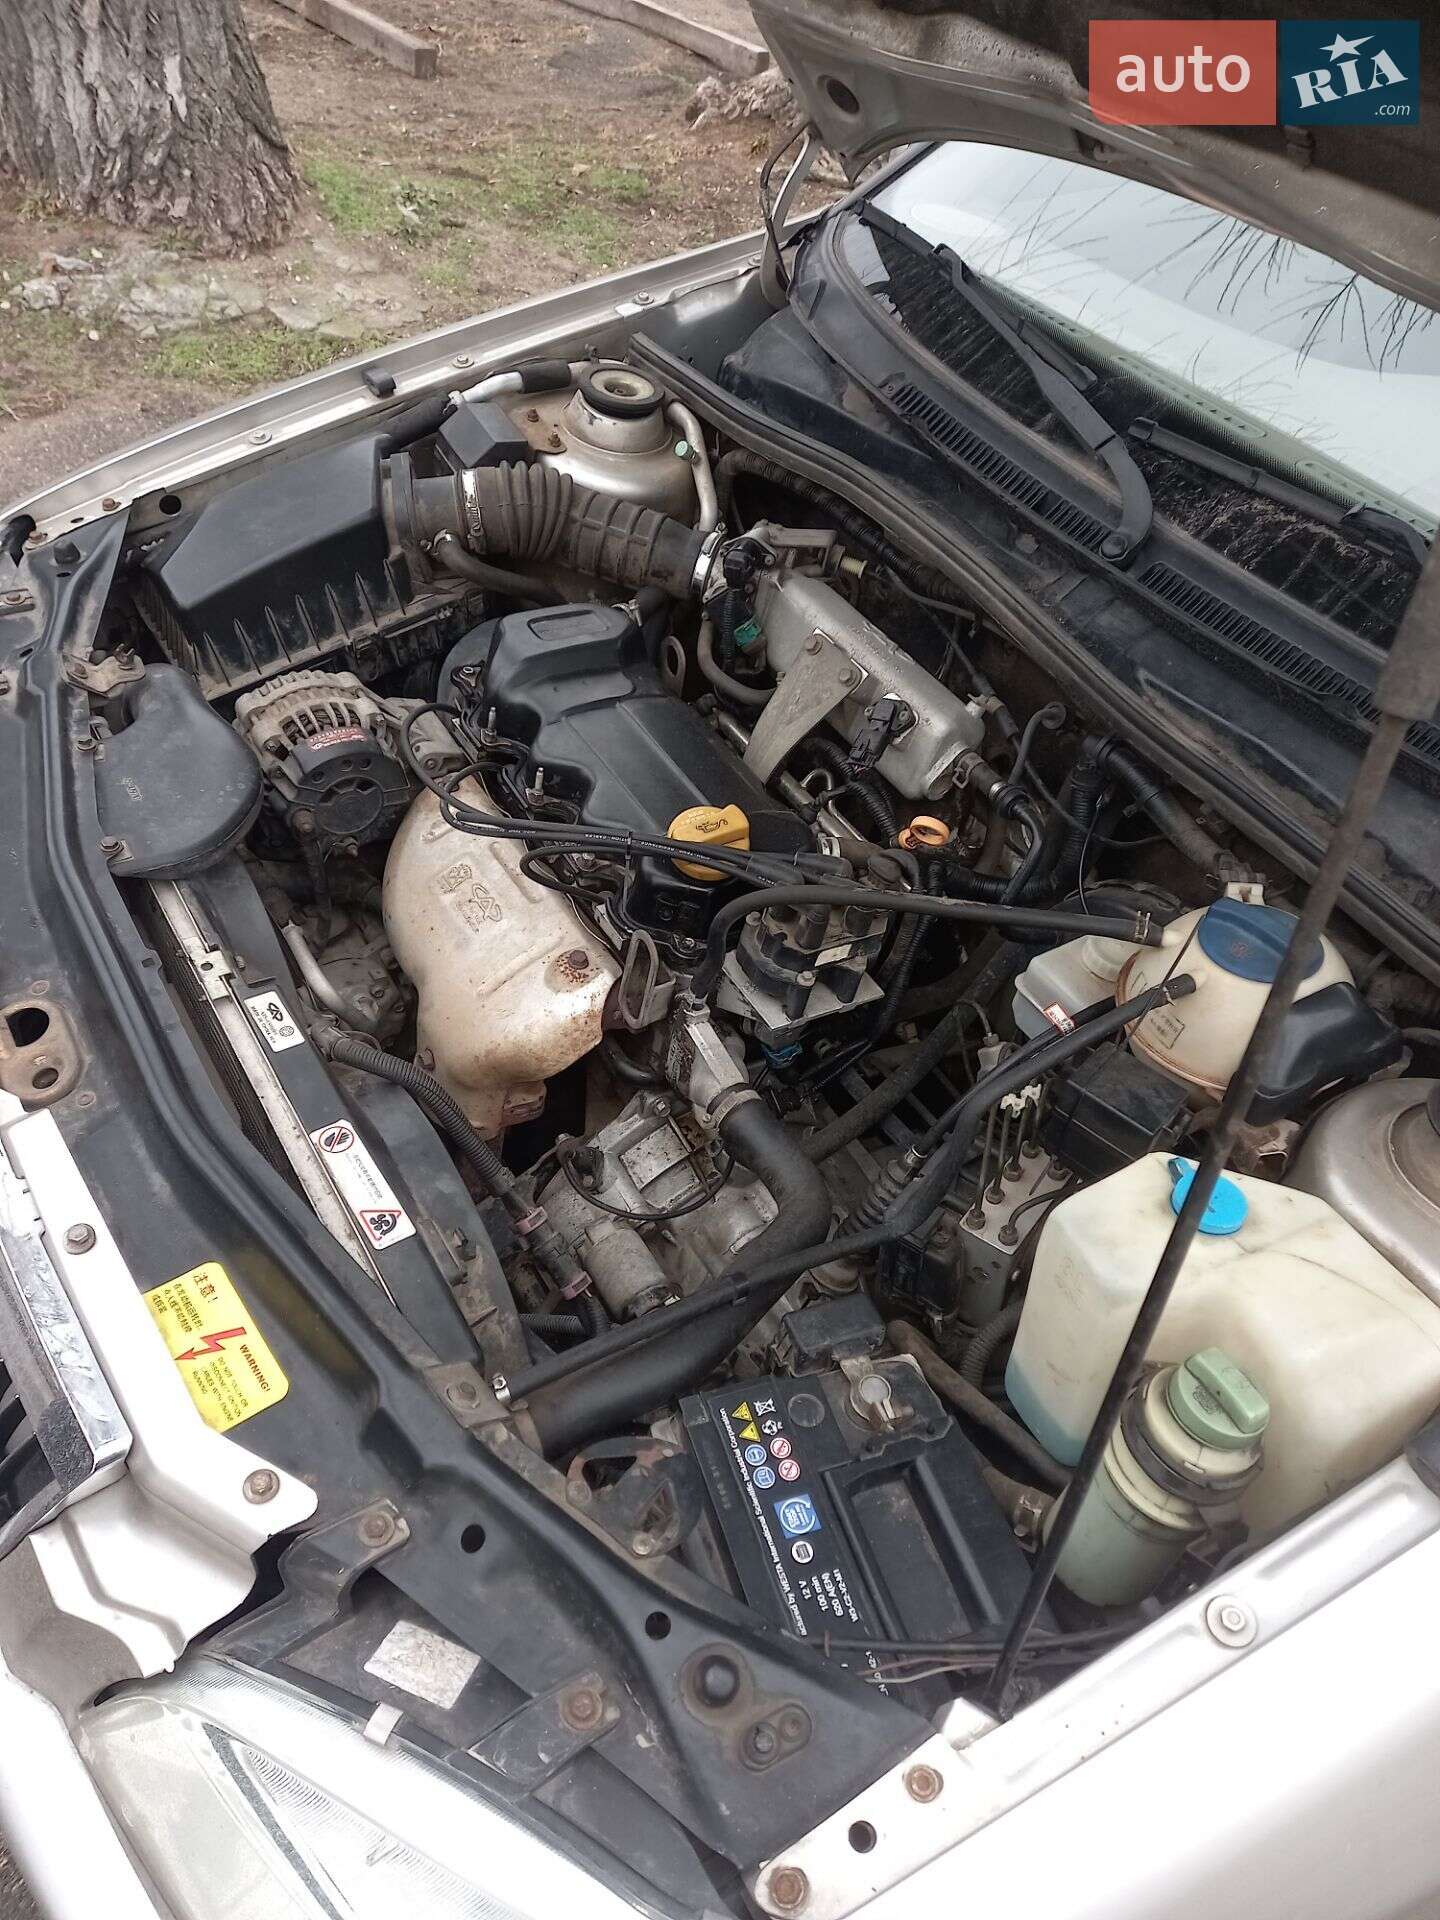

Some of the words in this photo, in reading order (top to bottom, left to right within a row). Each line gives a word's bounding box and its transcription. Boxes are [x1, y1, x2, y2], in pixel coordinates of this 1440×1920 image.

[239, 1344, 271, 1392] WARNING!
[719, 1407, 738, 1449] Corporation
[733, 1448, 750, 1481] Industrial
[746, 1481, 763, 1516] Scientific
[757, 1515, 780, 1563] International
[775, 1562, 791, 1593] WESTA
[798, 1580, 807, 1588] V
[811, 1576, 822, 1593] min
[821, 1572, 837, 1598] A(EN)
[787, 1592, 796, 1604] by
[802, 1588, 812, 1600] 12
[817, 1594, 829, 1611] 100
[831, 1599, 844, 1617] 620
